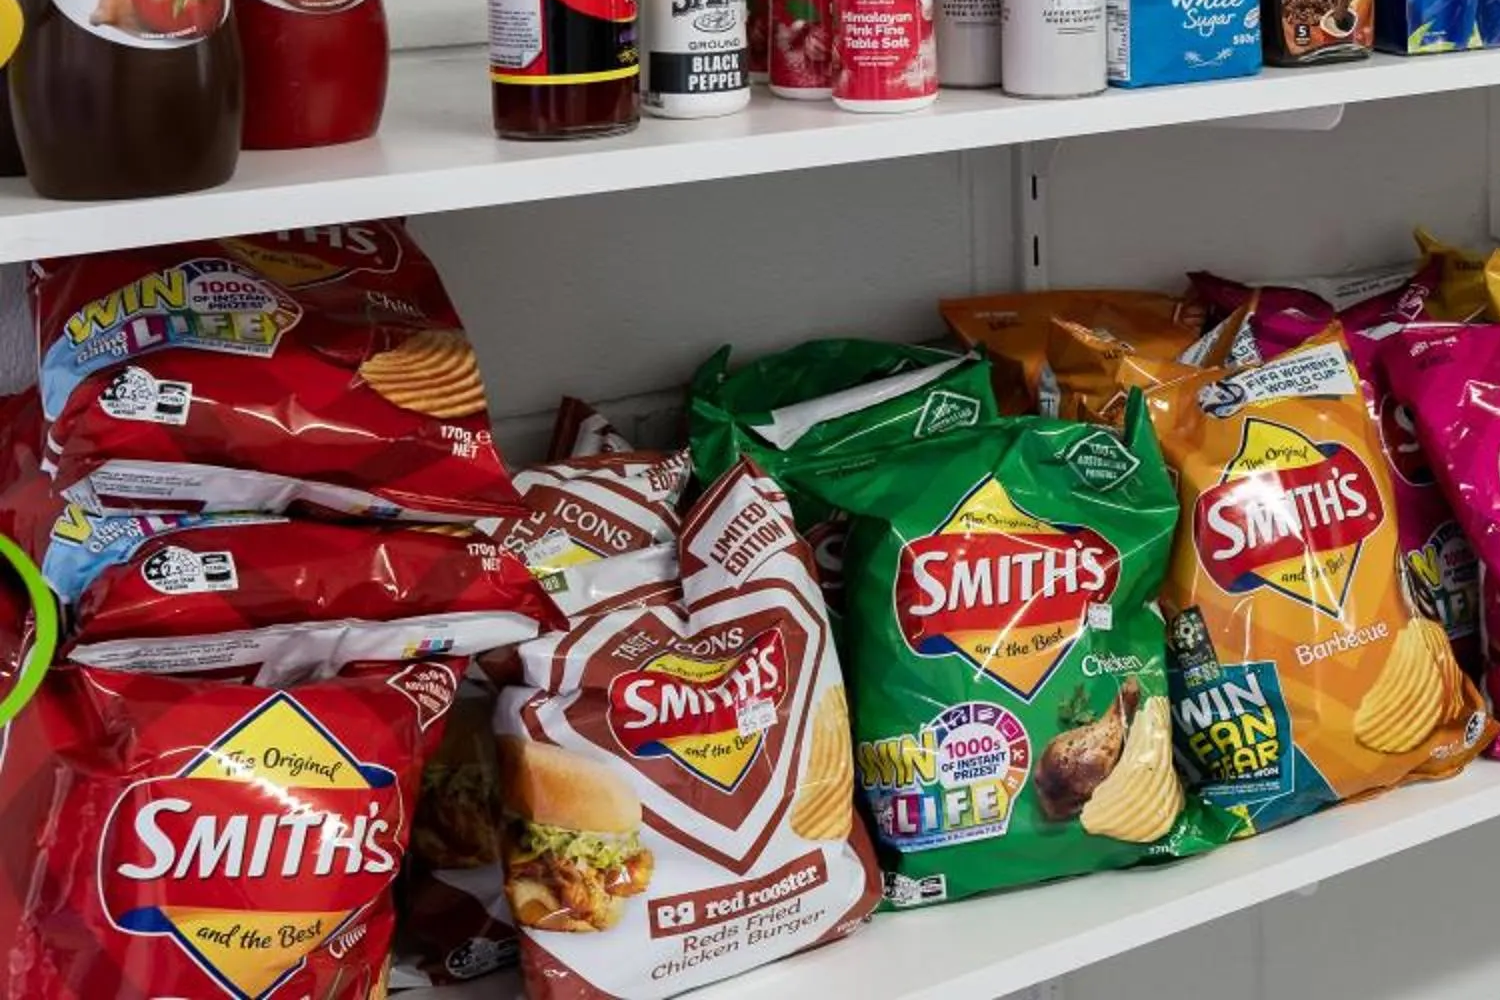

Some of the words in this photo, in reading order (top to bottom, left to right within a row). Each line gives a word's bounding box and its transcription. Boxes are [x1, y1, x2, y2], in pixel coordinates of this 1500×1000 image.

[842, 12, 913, 24] Himalayan
[846, 25, 872, 36] Pink
[876, 25, 904, 35] Fine
[1183, 9, 1236, 37] Sugar
[688, 39, 740, 50] GROUND
[845, 37, 878, 48] Table
[882, 37, 910, 48] Salt
[692, 54, 739, 72] BLACK
[688, 74, 741, 90] PEPPER
[66, 270, 186, 345] WIN
[1248, 370, 1280, 389] FIFA
[1281, 358, 1340, 377] WOMEN'S
[1266, 377, 1311, 393] WORLD
[1312, 369, 1337, 382] CUP
[439, 425, 473, 445] 170g
[451, 441, 479, 458] NET
[1240, 458, 1264, 470] The
[1265, 446, 1308, 462] Original
[553, 499, 633, 551] ICONS
[710, 500, 767, 565] LIMITED
[724, 519, 787, 577] EDITION
[909, 542, 1107, 617] SMITH'S
[1281, 566, 1307, 583] and
[1004, 639, 1030, 657] the
[1033, 628, 1065, 654] Best
[1295, 621, 1390, 665] Barbecue
[1082, 654, 1142, 677] Chicken
[1173, 672, 1267, 736] WIN
[684, 743, 710, 760] and
[713, 738, 733, 755] the
[858, 731, 936, 785] WIN
[941, 762, 955, 772] OF
[957, 751, 1007, 771] INSTANT
[945, 736, 1000, 759] 1000s
[262, 746, 342, 783] Original
[954, 765, 999, 781] PRIZES!
[897, 783, 1007, 834] LIFE
[704, 894, 746, 919] red
[748, 864, 818, 907] rooster
[196, 924, 236, 948] and
[240, 927, 273, 949] the
[278, 918, 324, 949] Best
[682, 925, 739, 955] Reds
[746, 900, 803, 934] Fried
[650, 944, 742, 981] Chicken
[747, 909, 827, 953] Burger
